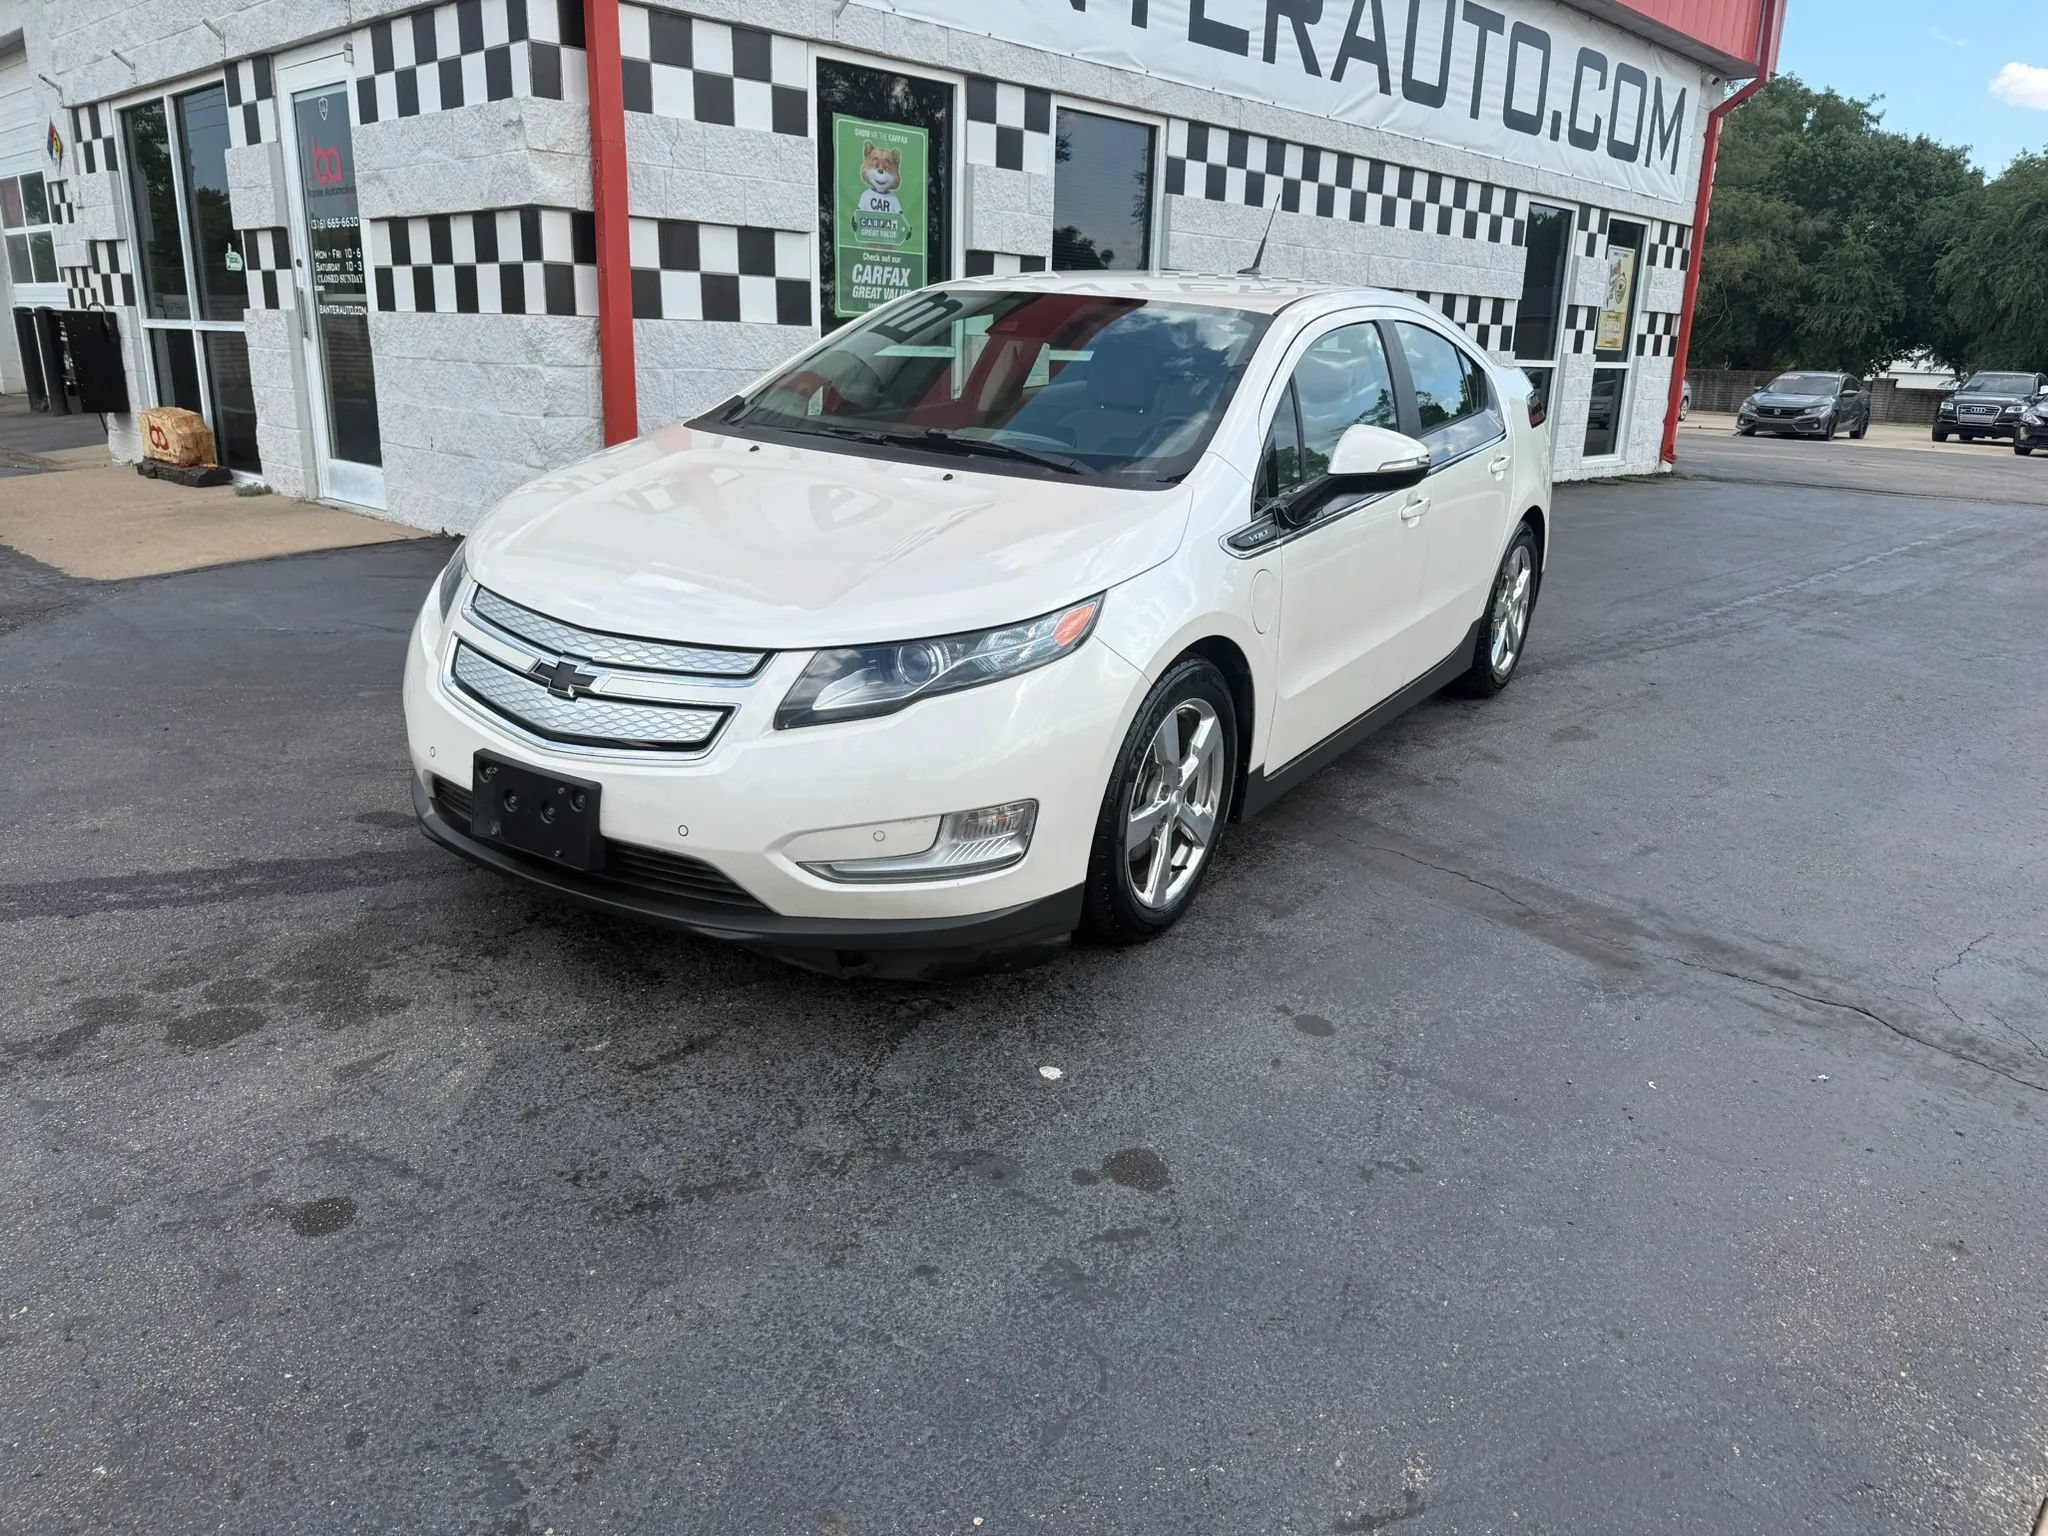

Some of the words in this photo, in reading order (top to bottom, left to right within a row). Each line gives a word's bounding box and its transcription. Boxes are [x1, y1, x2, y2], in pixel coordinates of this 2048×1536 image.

[888, 134, 909, 144] CARFAX
[870, 198, 890, 212] CAR
[327, 216, 359, 228] 665-6630
[860, 218, 898, 231] CARFAX
[861, 228, 879, 237] GREAT
[880, 230, 897, 238] VALUE
[862, 252, 880, 261] Check
[881, 255, 891, 263] out
[317, 274, 339, 283] CLOSED
[340, 273, 363, 283] SUNDAY
[851, 263, 911, 287] CARFAX
[852, 285, 882, 299] GREAT
[319, 304, 367, 315] BANTERAUTO.COM
